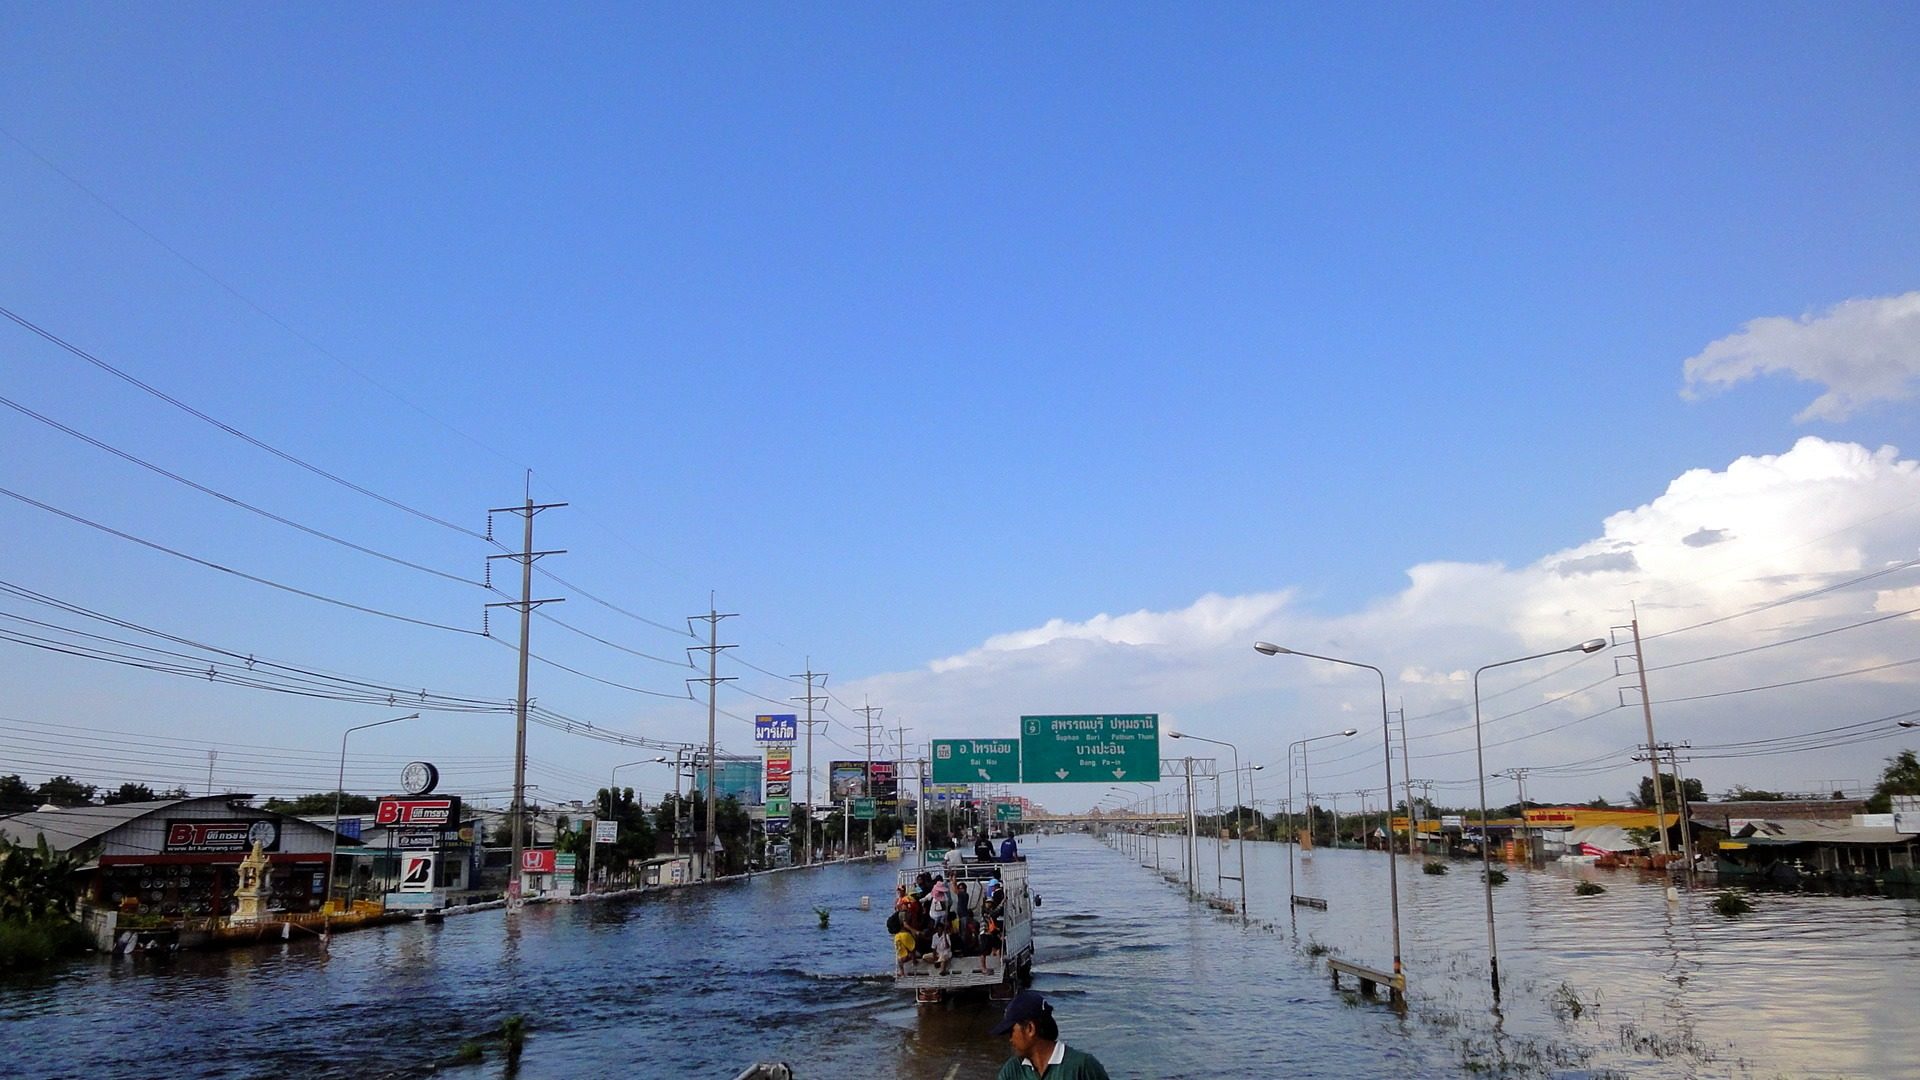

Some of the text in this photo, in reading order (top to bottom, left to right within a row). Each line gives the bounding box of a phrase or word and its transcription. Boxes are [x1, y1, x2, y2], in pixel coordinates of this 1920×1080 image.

[1051, 717, 1154, 733] สุพรรณบุรี ปทุมธานี
[969, 740, 1011, 754] ไทรน้อย
[1076, 742, 1125, 755] บางปะอิน
